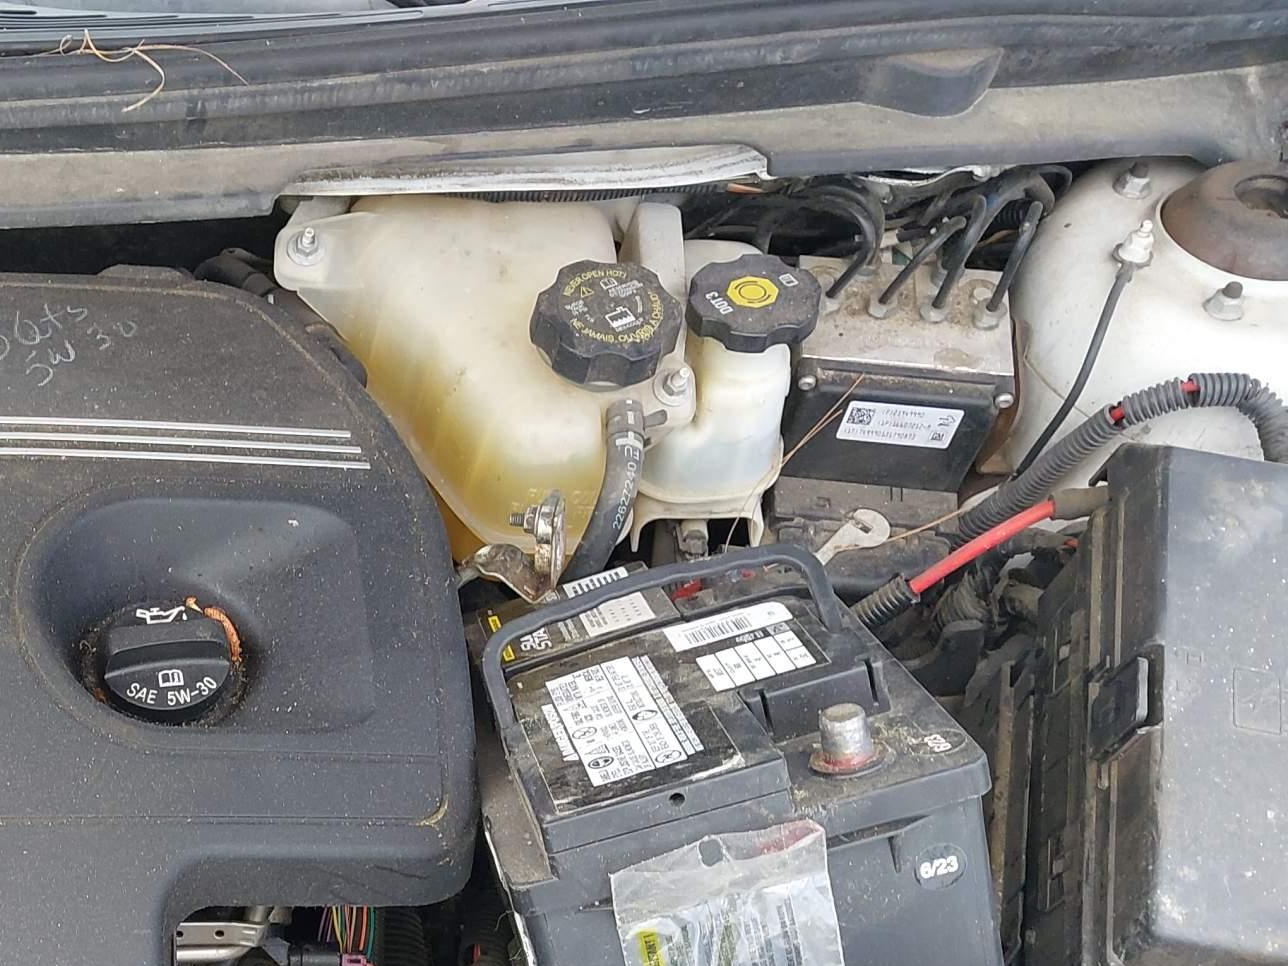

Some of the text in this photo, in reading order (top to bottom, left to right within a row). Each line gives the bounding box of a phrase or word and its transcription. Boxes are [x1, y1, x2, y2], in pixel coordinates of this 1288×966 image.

[126, 676, 218, 706] SAE 5W-30
[919, 854, 959, 880] 6/23
